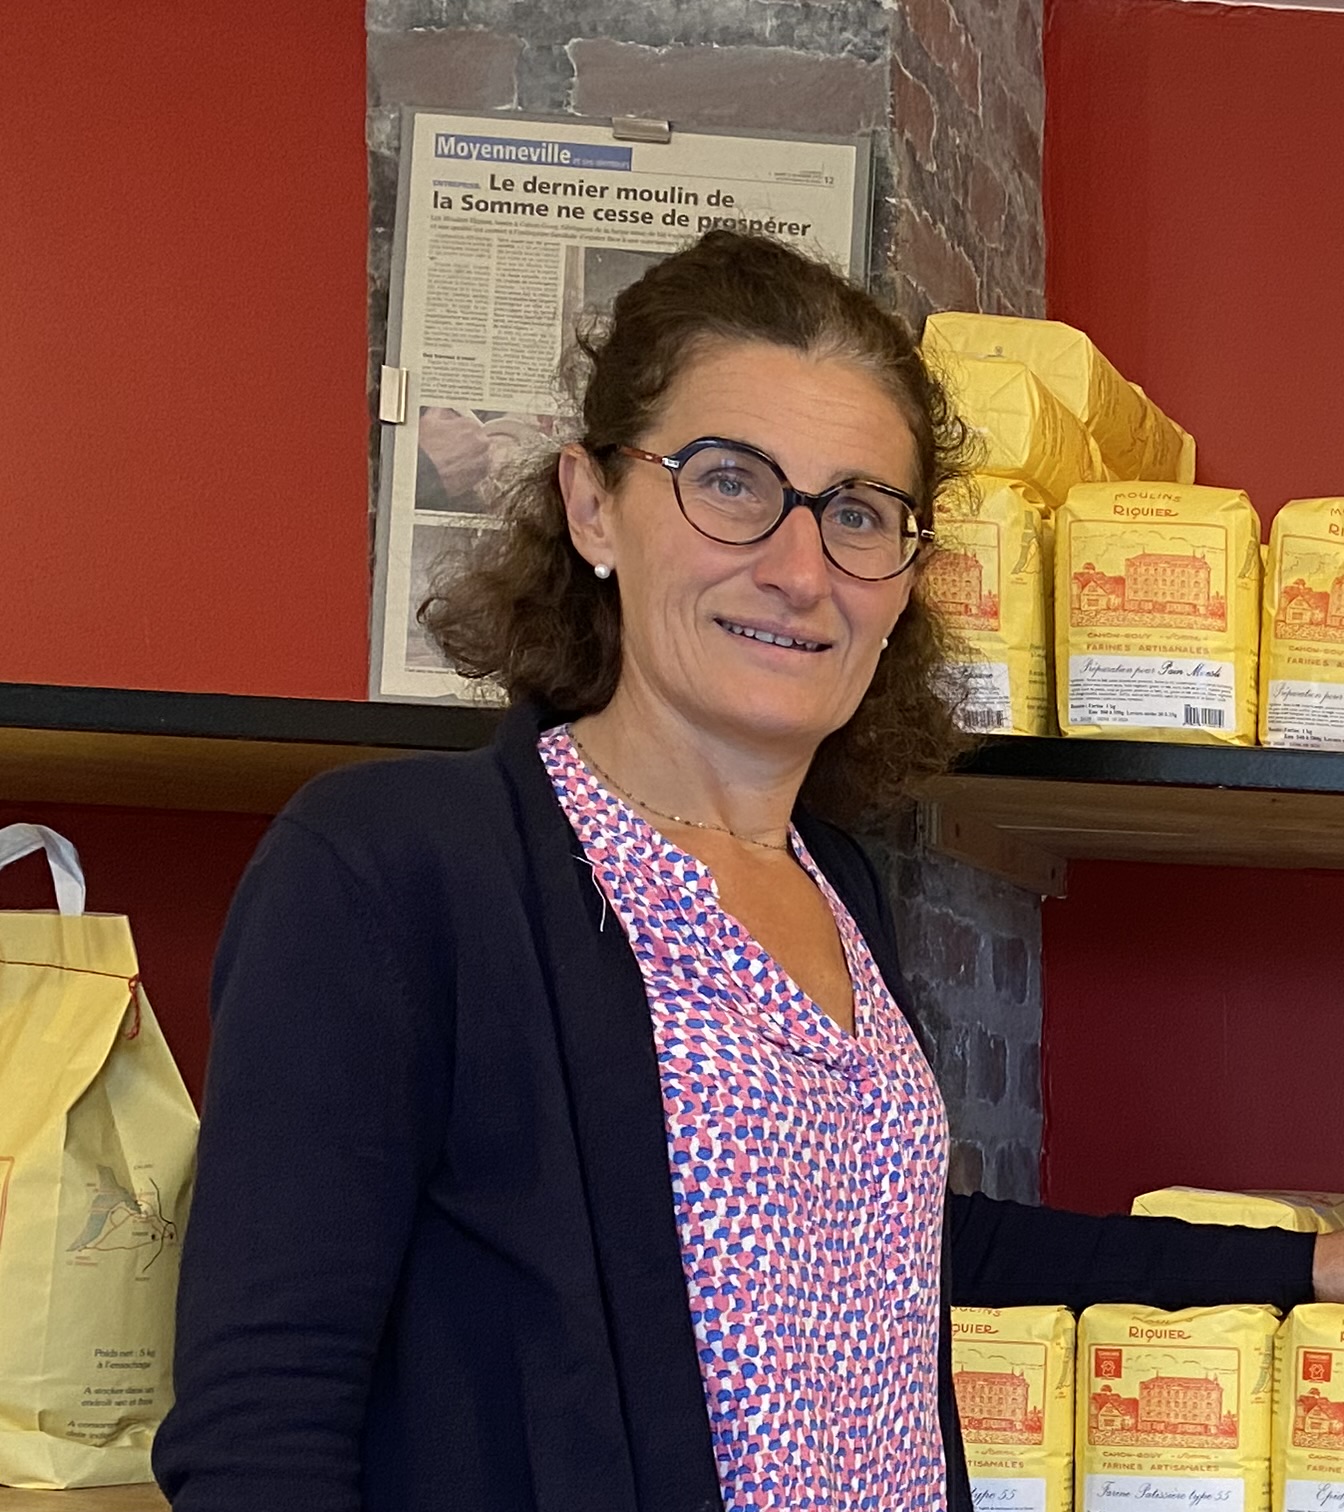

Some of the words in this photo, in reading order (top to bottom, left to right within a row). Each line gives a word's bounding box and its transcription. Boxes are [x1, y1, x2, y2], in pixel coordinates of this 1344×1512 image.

[437, 136, 571, 164] Moyenneville
[490, 174, 515, 192] Le
[523, 176, 609, 200] dernier
[616, 186, 699, 206] moulin
[706, 190, 735, 208] de
[433, 191, 452, 211] la
[461, 194, 549, 218] Somme
[557, 205, 586, 220] ne
[593, 208, 654, 225] cesse
[662, 209, 690, 228] de
[697, 216, 811, 237] prospérer
[1114, 491, 1182, 503] MOULINS
[1113, 505, 1179, 520] RIQUIER
[1128, 1325, 1192, 1343] RIQUIER
[1150, 1463, 1220, 1473] ARTISANALES
